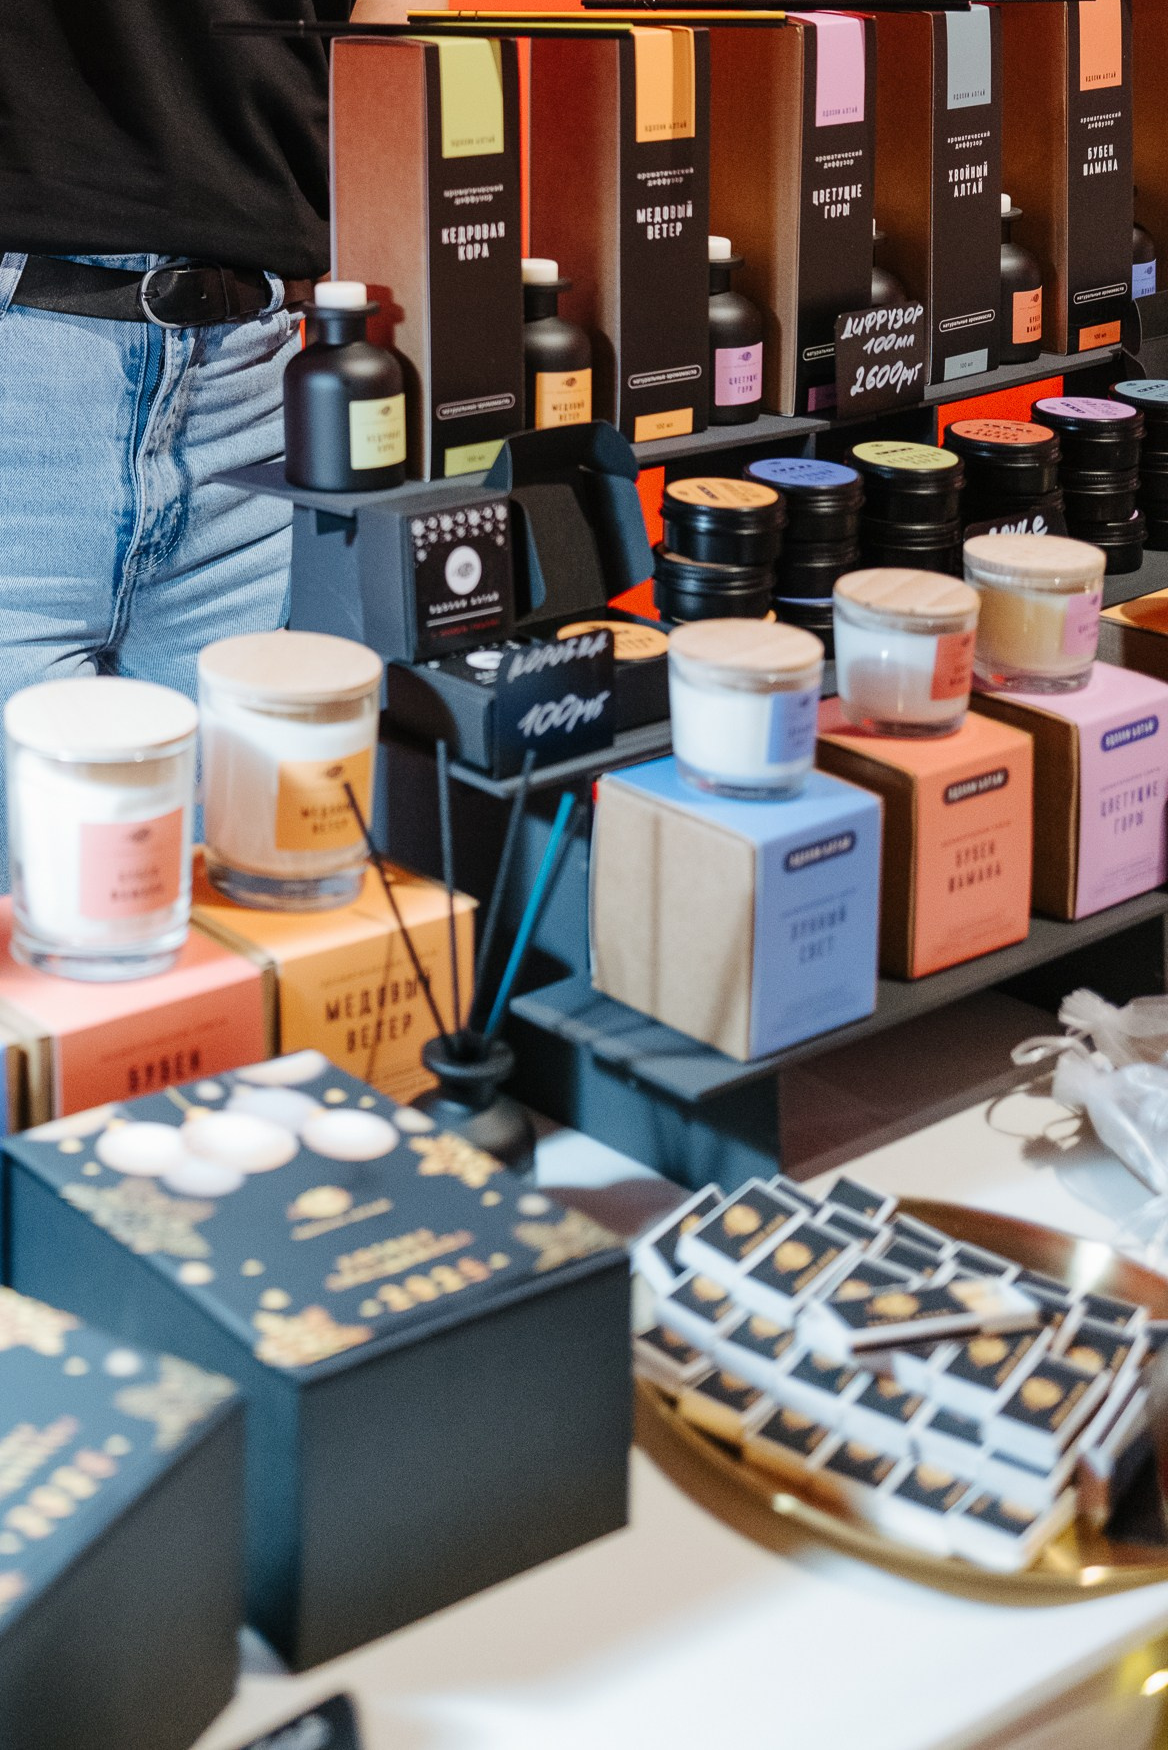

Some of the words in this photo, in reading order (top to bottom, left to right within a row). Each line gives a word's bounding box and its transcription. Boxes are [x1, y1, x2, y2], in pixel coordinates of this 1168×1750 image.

[1087, 143, 1114, 161] БУБЕН
[948, 160, 988, 183] ХВОЙНЫЙ
[1082, 158, 1119, 177] ШАМАНА
[812, 183, 863, 207] ЦВЕТУЩИЕ
[953, 178, 983, 198] АЛТАЙ
[636, 199, 693, 224] МЕДОВЫЙ
[824, 202, 850, 220] ГОРЫ
[441, 221, 506, 245] КЕДРОВАЯ
[646, 221, 683, 241] ВЕТЕР
[457, 242, 490, 262] КОРА
